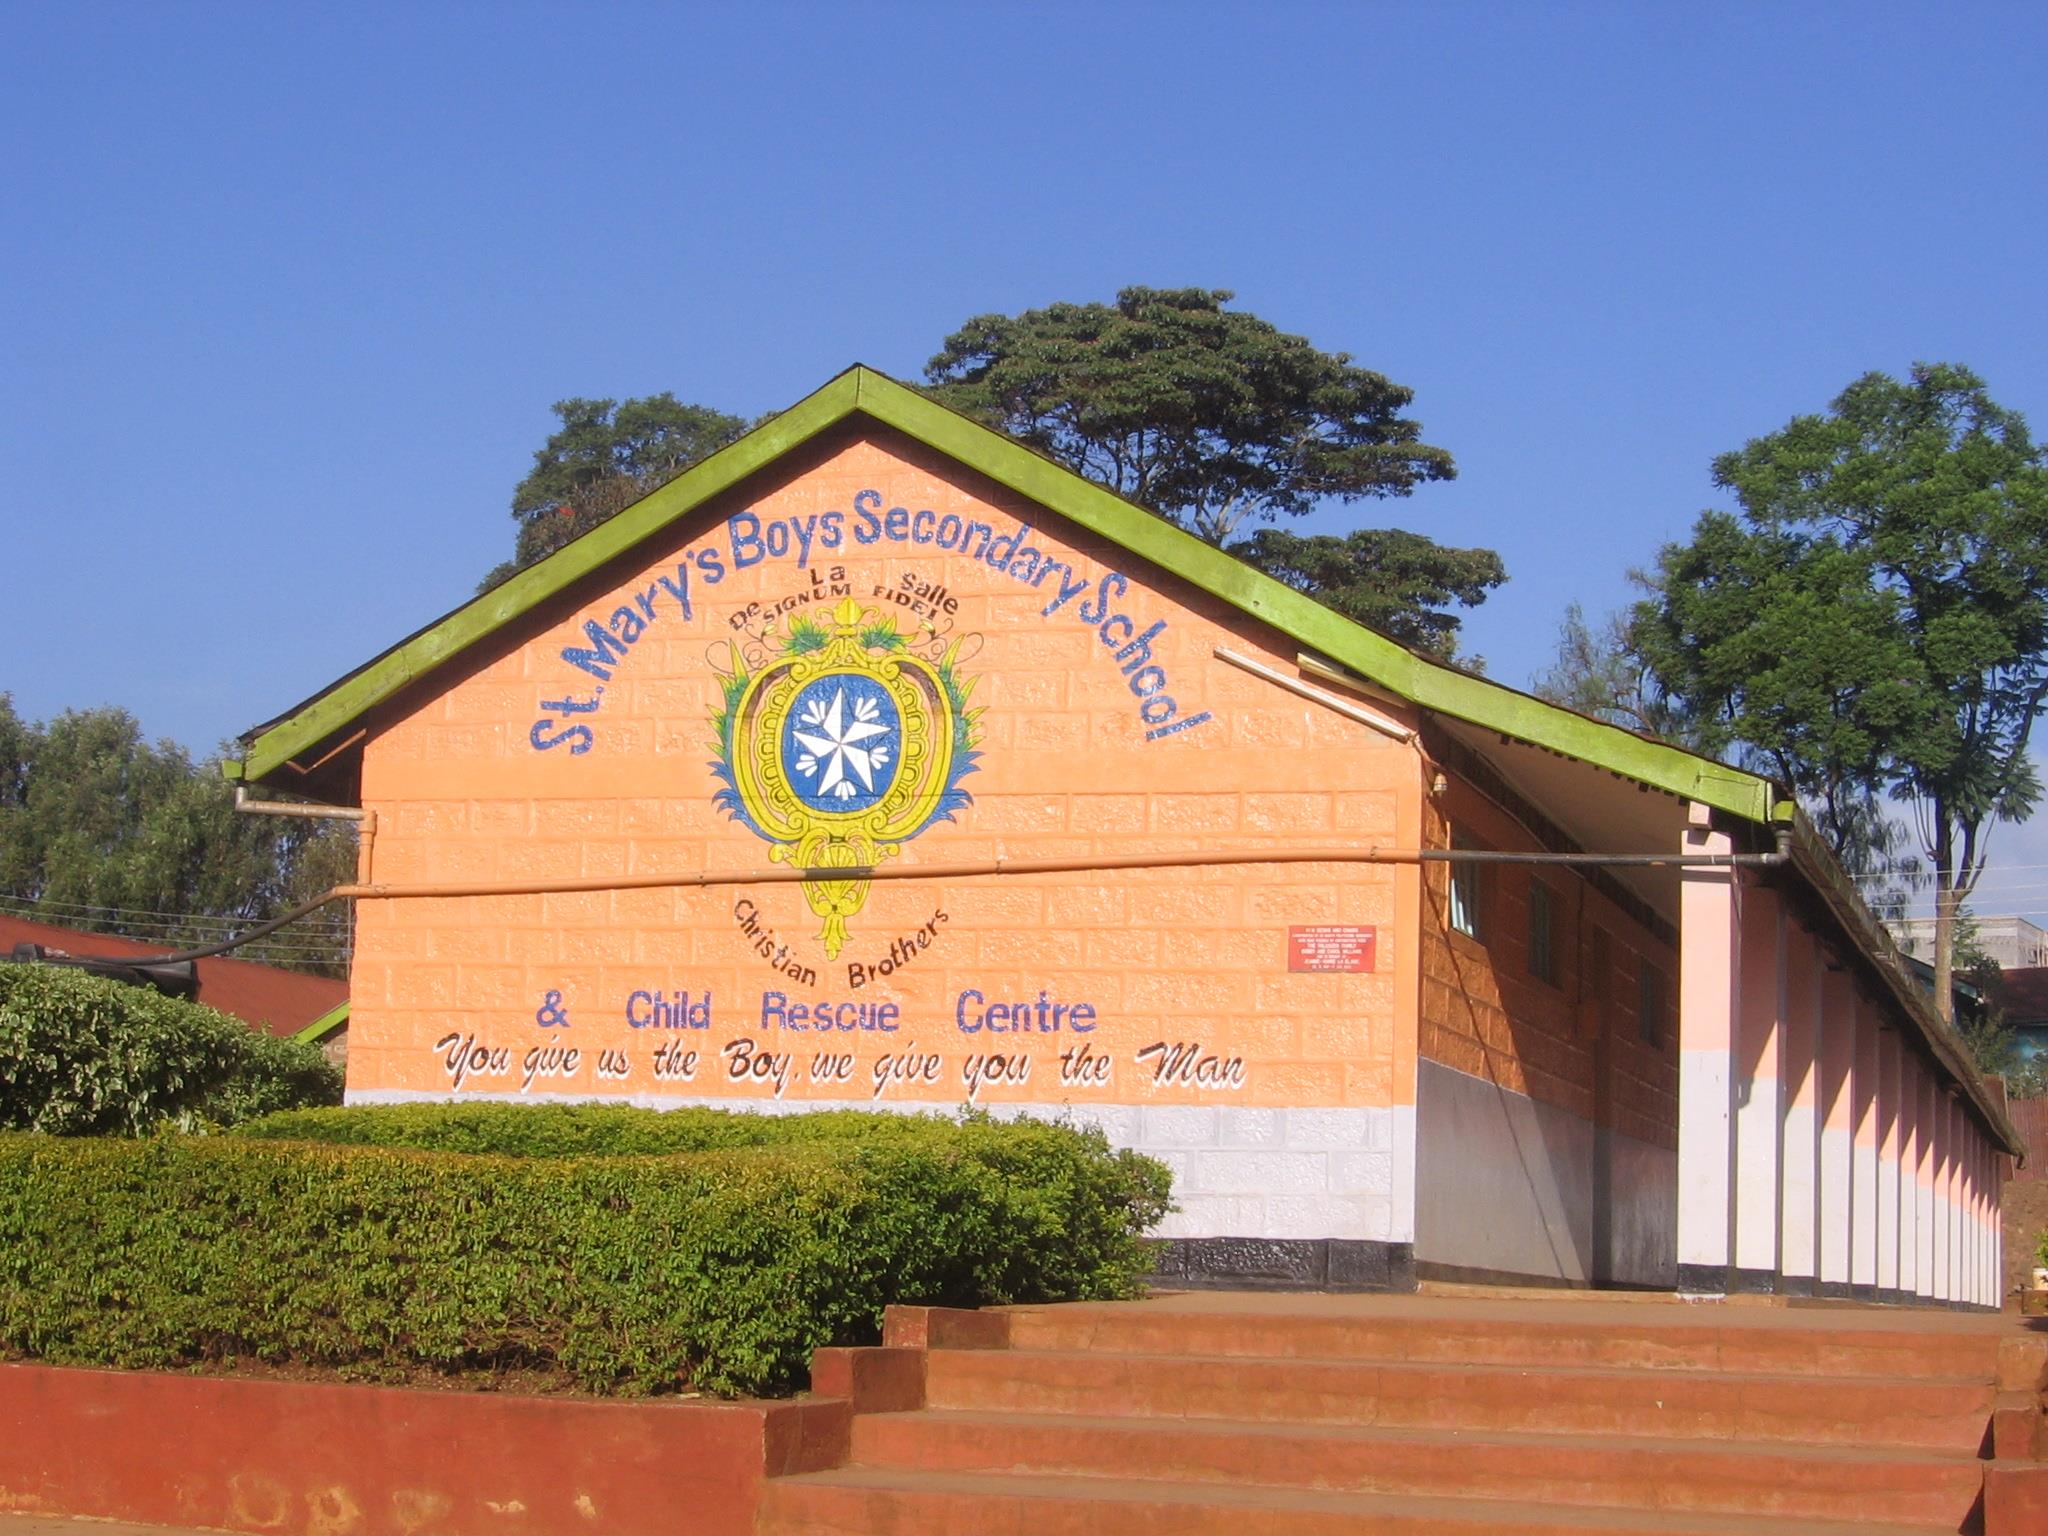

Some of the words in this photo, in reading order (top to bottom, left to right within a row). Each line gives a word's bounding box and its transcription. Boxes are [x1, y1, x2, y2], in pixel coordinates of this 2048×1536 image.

[727, 511, 845, 568] Boys
[853, 489, 1090, 617] Secondary
[559, 547, 725, 681] Mary's
[728, 601, 761, 631] De
[810, 565, 846, 586] La
[901, 572, 958, 615] Salle
[763, 583, 851, 623] SIGNUM
[873, 585, 939, 621] FIDEI
[1078, 572, 1212, 742] School
[529, 684, 604, 756] St.
[734, 899, 816, 987] Christian
[848, 908, 948, 989] Brothers
[536, 990, 571, 1028] &
[626, 991, 711, 1030] Child
[761, 992, 899, 1032] Rescue
[956, 989, 1097, 1033] Centre
[434, 1033, 511, 1092] You
[522, 1034, 581, 1094] give
[597, 1044, 630, 1080] us
[653, 1038, 701, 1081] the
[811, 1048, 856, 1083] we
[873, 1041, 942, 1099] give
[962, 1054, 1032, 1104] you
[1060, 1042, 1115, 1086] the
[1135, 1041, 1250, 1090] Man
